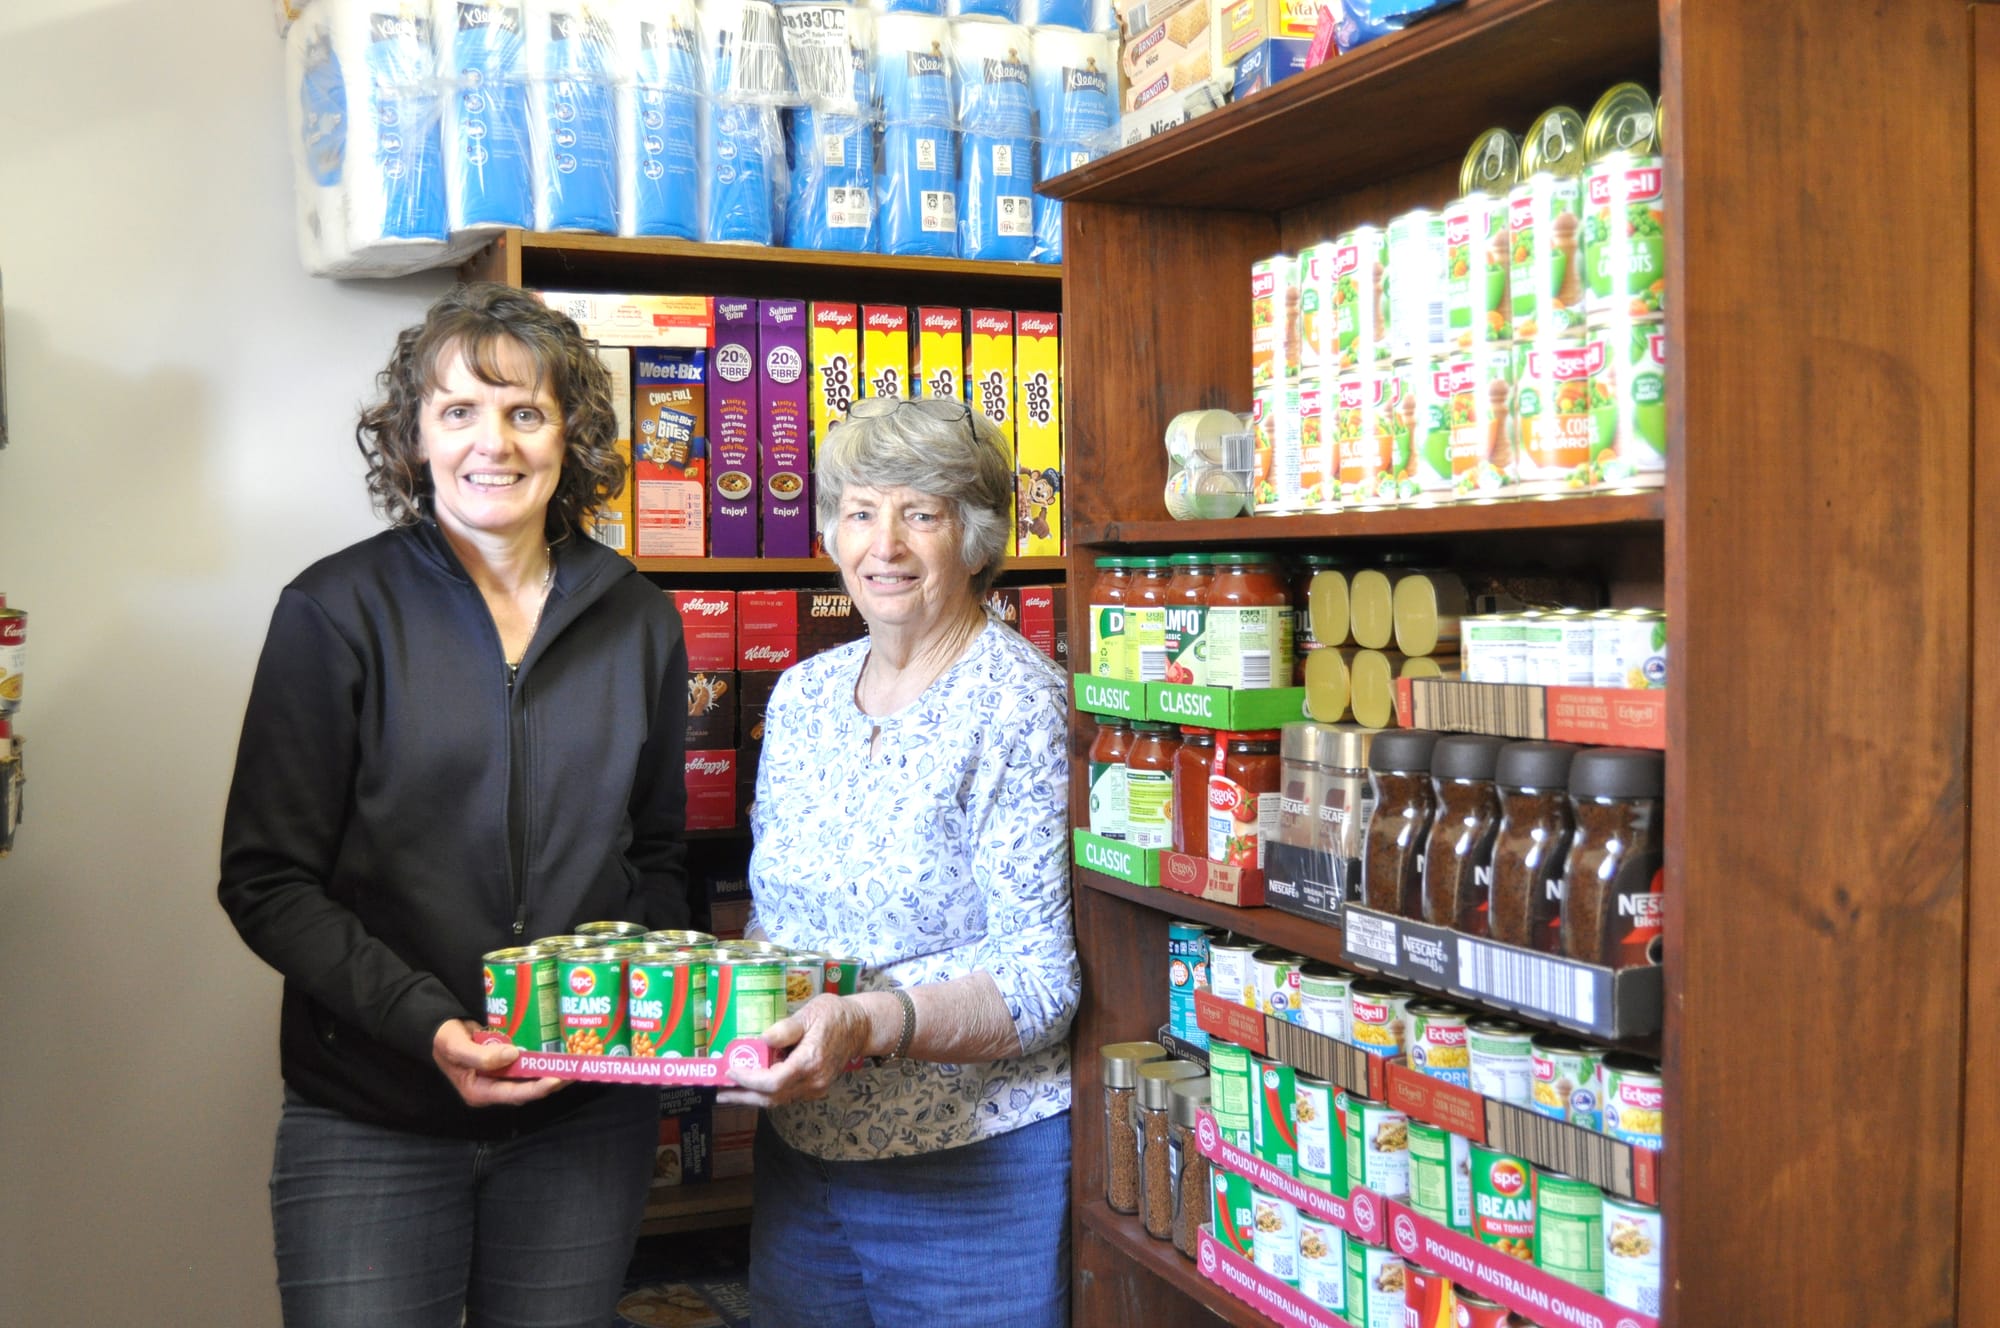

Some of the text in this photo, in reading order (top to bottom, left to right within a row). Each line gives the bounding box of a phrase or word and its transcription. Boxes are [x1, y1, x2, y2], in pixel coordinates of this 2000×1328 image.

[1145, 54, 1159, 68] Nice
[1067, 71, 1108, 93] Kleenex
[719, 303, 747, 314] Sultana
[725, 312, 743, 321] Bran
[769, 306, 797, 317] Sultana
[817, 306, 852, 326] Kellogg's
[775, 314, 793, 323] Bran
[868, 311, 903, 329] Kellogg's
[924, 312, 958, 330] Kellogg's
[976, 314, 1009, 332] Kellogg's
[1021, 316, 1054, 333] Kellogg's
[720, 350, 748, 363] 20%
[771, 352, 798, 366] 20%
[640, 361, 703, 380] Weet-Bix
[720, 367, 747, 377] FIBRE
[771, 369, 798, 378] FIBRE
[649, 391, 672, 407] CHOC
[672, 388, 693, 402] FULL
[660, 410, 693, 427] Weet-Bix
[721, 506, 748, 517] Enjoy!
[773, 507, 800, 517] Enjoy!
[682, 598, 729, 616] Kellogg's
[811, 606, 850, 618] GRAIN
[744, 645, 793, 663] Kellogg's
[1086, 684, 1131, 712] CLASSIC
[1160, 690, 1213, 718] CLASSIC
[1085, 843, 1131, 875] CLASSIC
[1329, 897, 1336, 910] 5
[571, 977, 592, 990] spc
[565, 996, 611, 1014] BEANS
[579, 1016, 602, 1025] TOMATO
[520, 1056, 718, 1077] PROUDLY AUSTRALIAN OWNED
[1222, 1147, 1345, 1220] PROUDLY AUSTRALIAN OWNED
[1494, 1172, 1521, 1189] spc
[1482, 1193, 1532, 1221] BEAN
[1425, 1237, 1604, 1328] PROUDLY AUSTRALIAN OWNED
[1221, 1259, 1308, 1324] PROUDLY AUSTRALIAN
